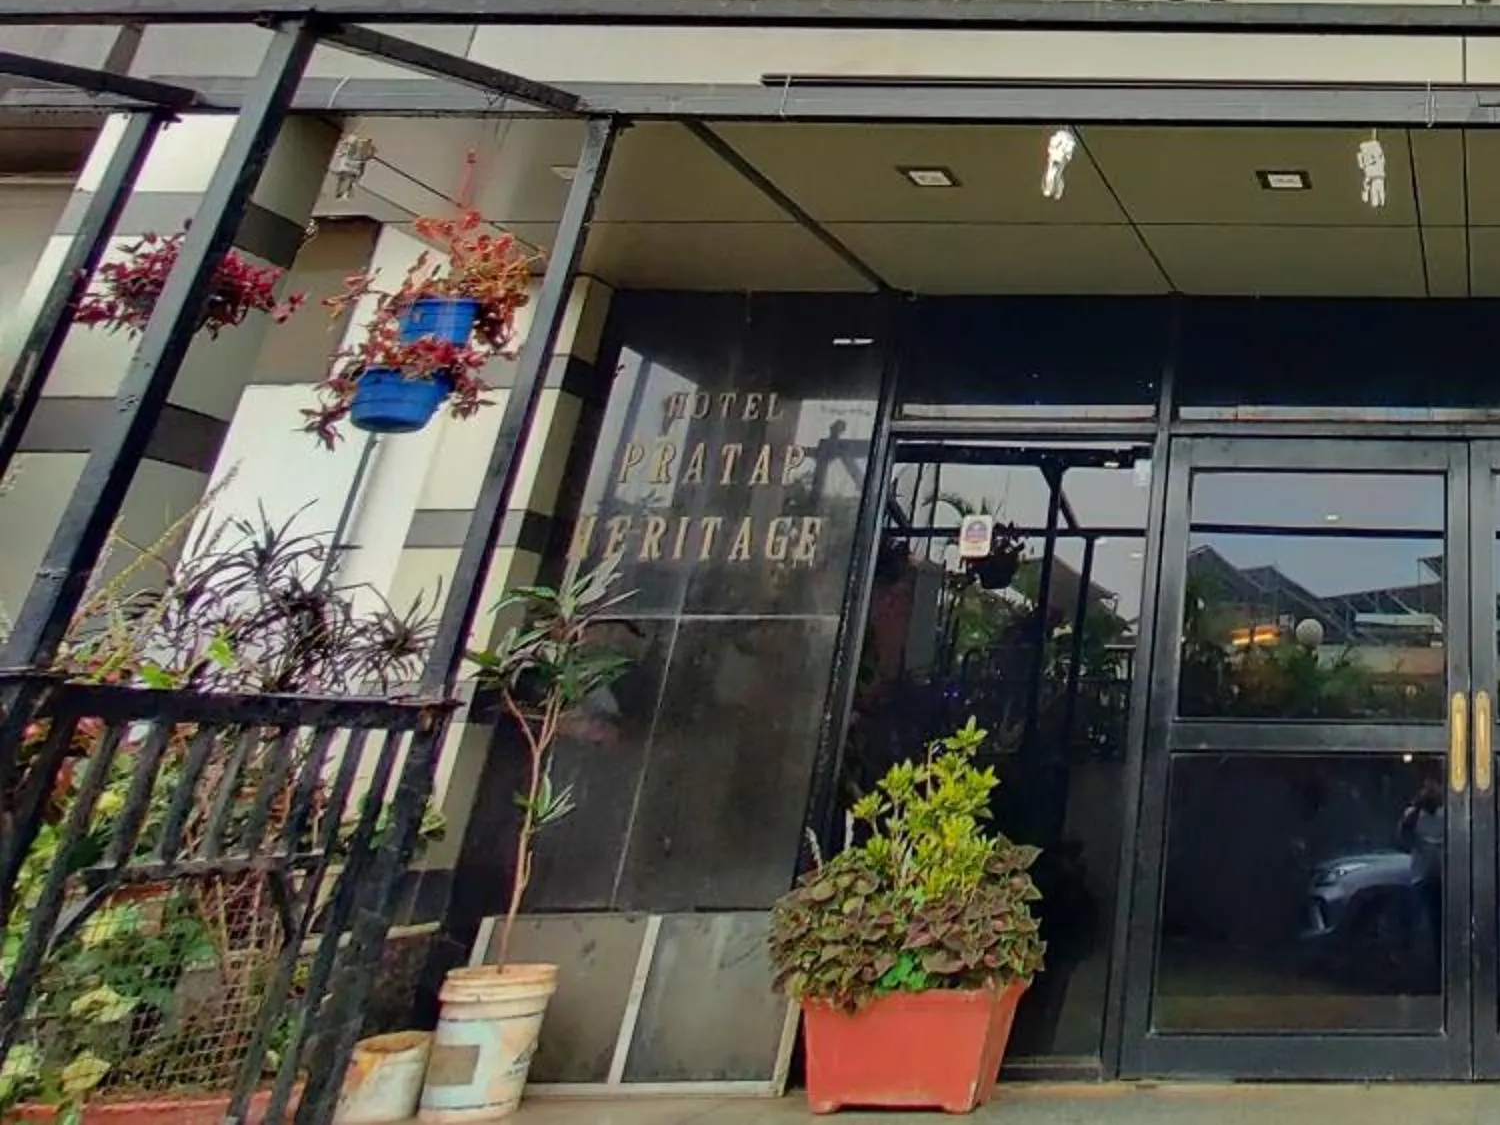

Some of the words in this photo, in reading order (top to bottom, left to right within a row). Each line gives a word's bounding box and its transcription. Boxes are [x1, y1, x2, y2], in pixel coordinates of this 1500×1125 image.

[662, 391, 785, 422] HOTEL
[616, 441, 808, 486] PRATAP
[566, 515, 825, 563] HERITAGE
